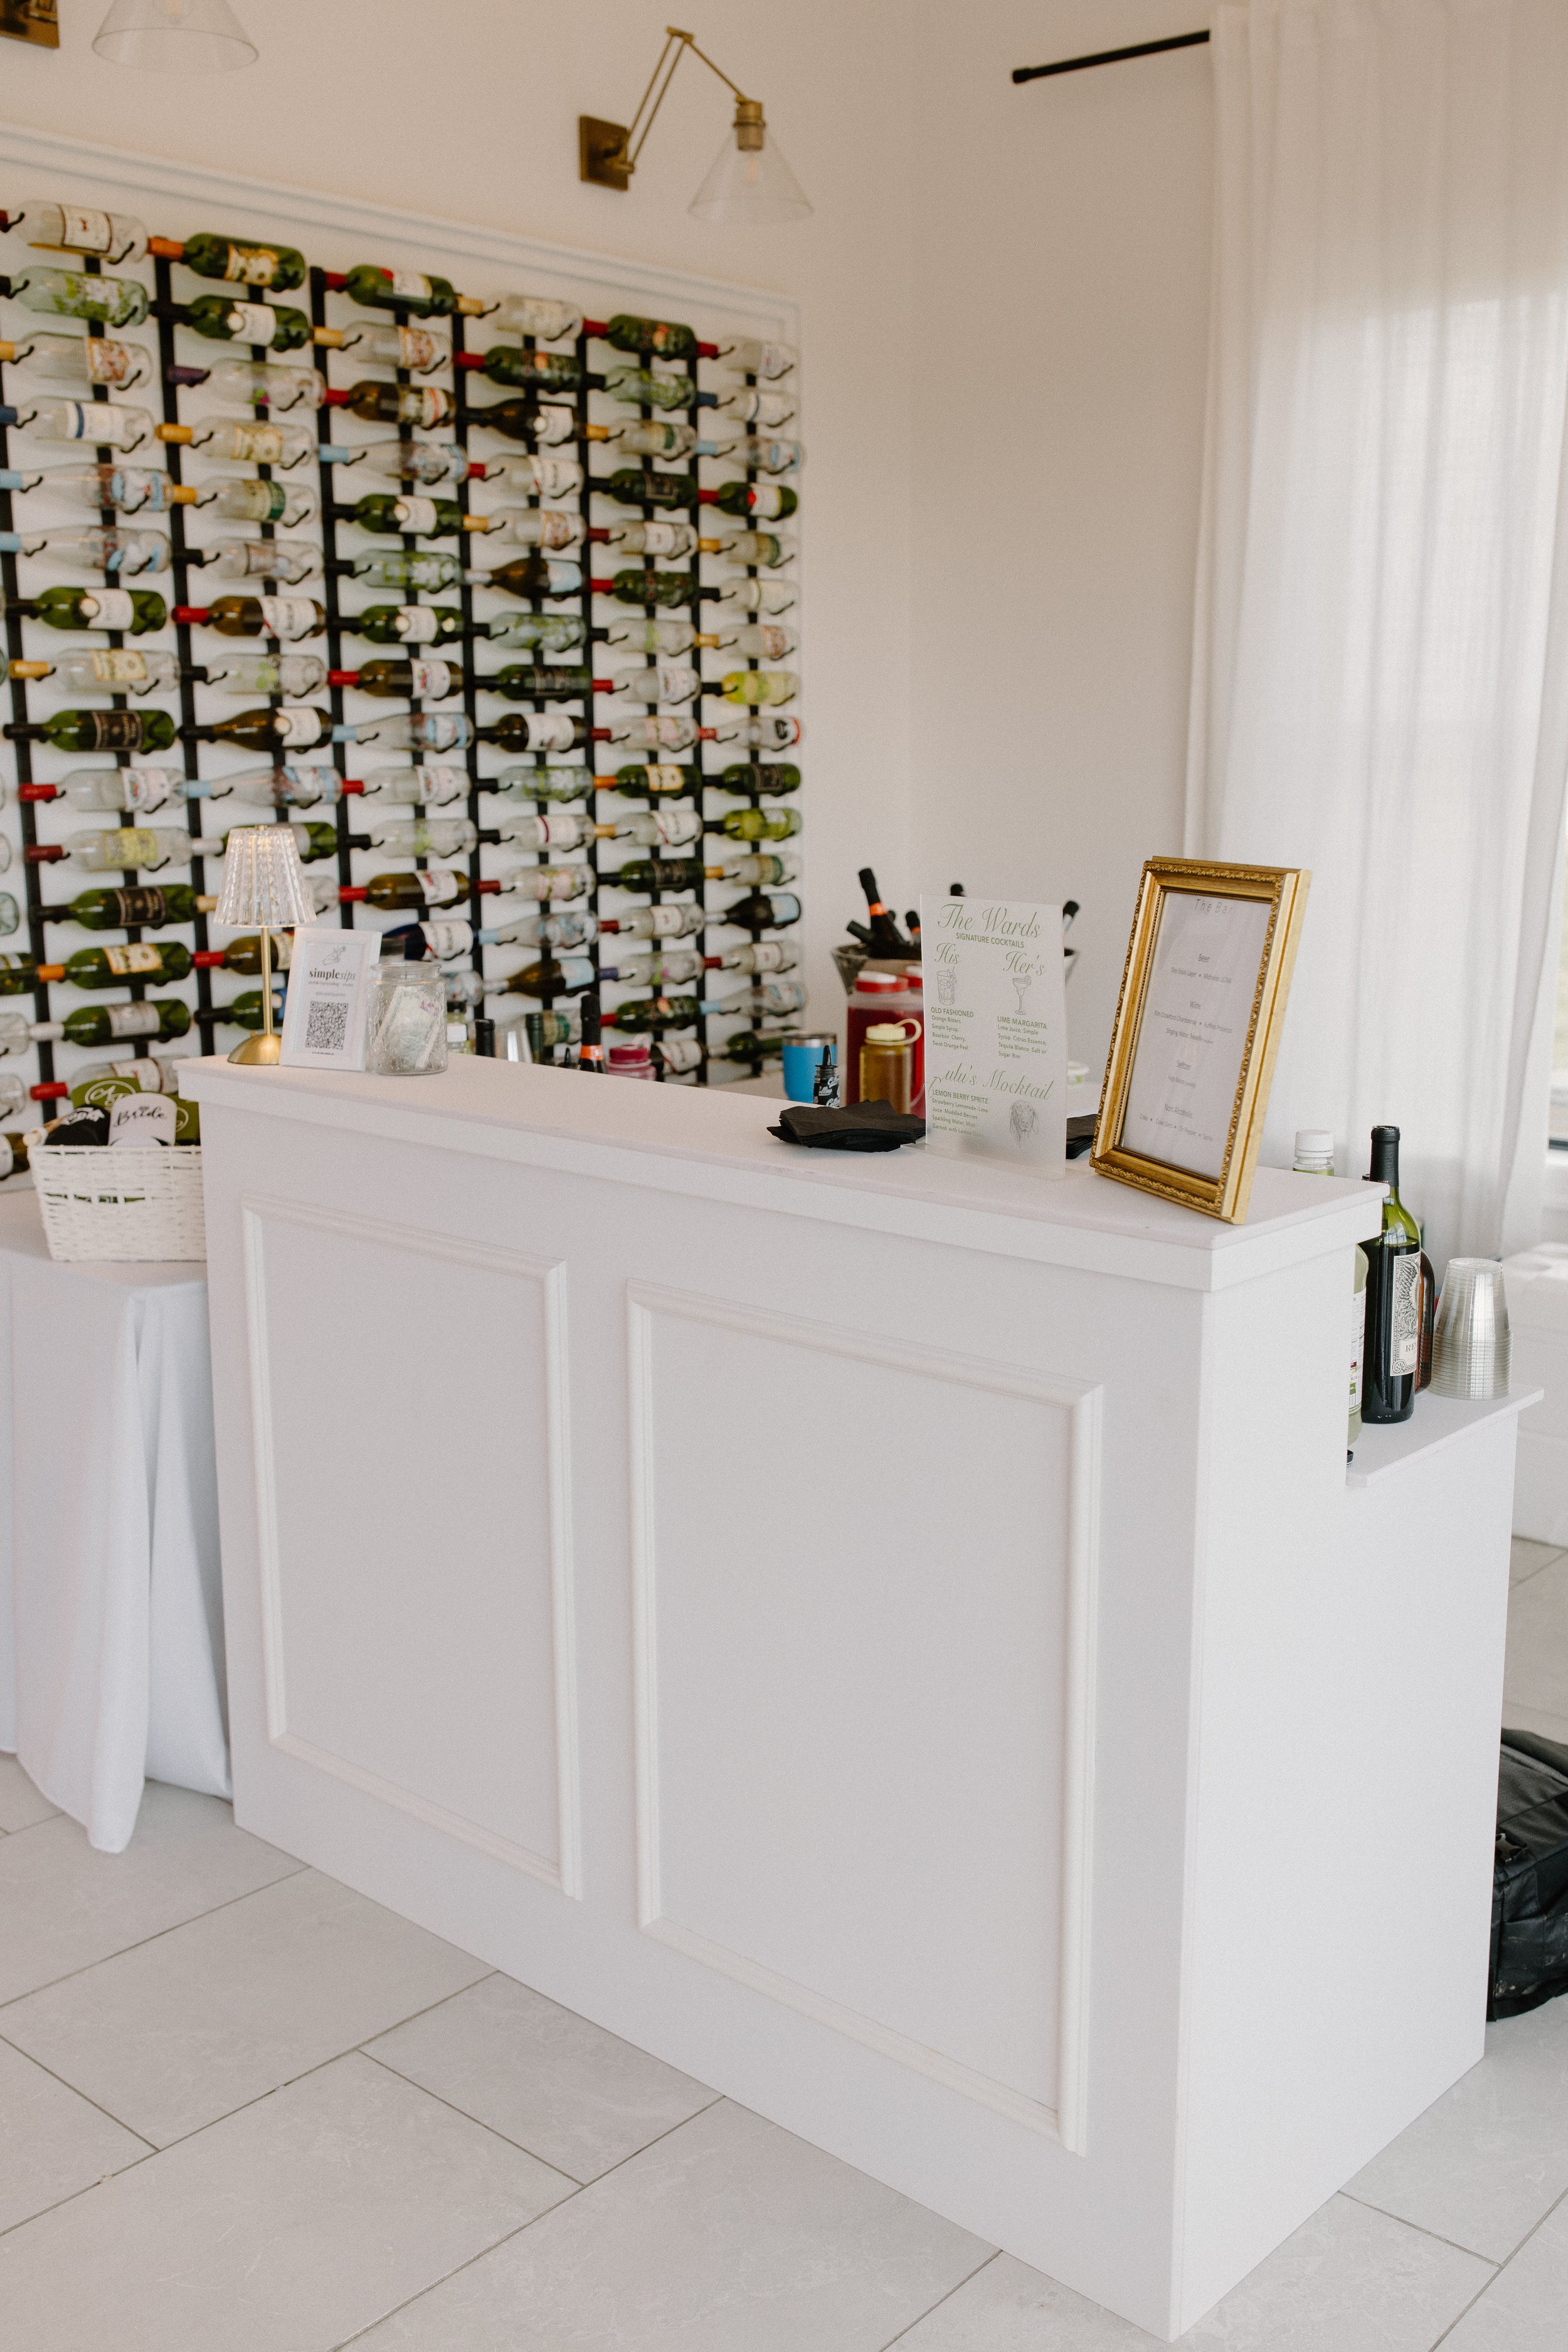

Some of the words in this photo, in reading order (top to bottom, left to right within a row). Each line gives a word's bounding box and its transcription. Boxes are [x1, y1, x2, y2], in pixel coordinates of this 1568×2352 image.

[1194, 899, 1212, 912] The
[1215, 902, 1234, 914] Bar
[938, 903, 974, 930] The
[982, 907, 1043, 938] Wards
[956, 932, 989, 943] SIGNATURE
[991, 937, 1024, 948] COCKTAILS
[935, 943, 961, 965] His
[1198, 953, 1210, 963] Beer
[1003, 951, 1044, 976] Her's
[931, 1015, 946, 1023] Orange
[943, 1009, 974, 1018] FASHIONED
[997, 1015, 1010, 1024] LIME
[1012, 1018, 1047, 1029] MARGARITA
[943, 1042, 959, 1050] Orange
[983, 1069, 1054, 1100] Mocktail
[932, 1089, 951, 1098] LEMON
[953, 1092, 970, 1101] BERRY
[970, 1095, 988, 1104] SPRITZ
[932, 1098, 954, 1108] Strawberry
[113, 1104, 167, 1128] Bride
[944, 1108, 963, 1116] Muddled
[932, 1115, 951, 1124] Sparkling
[932, 1123, 948, 1131] Garnish
